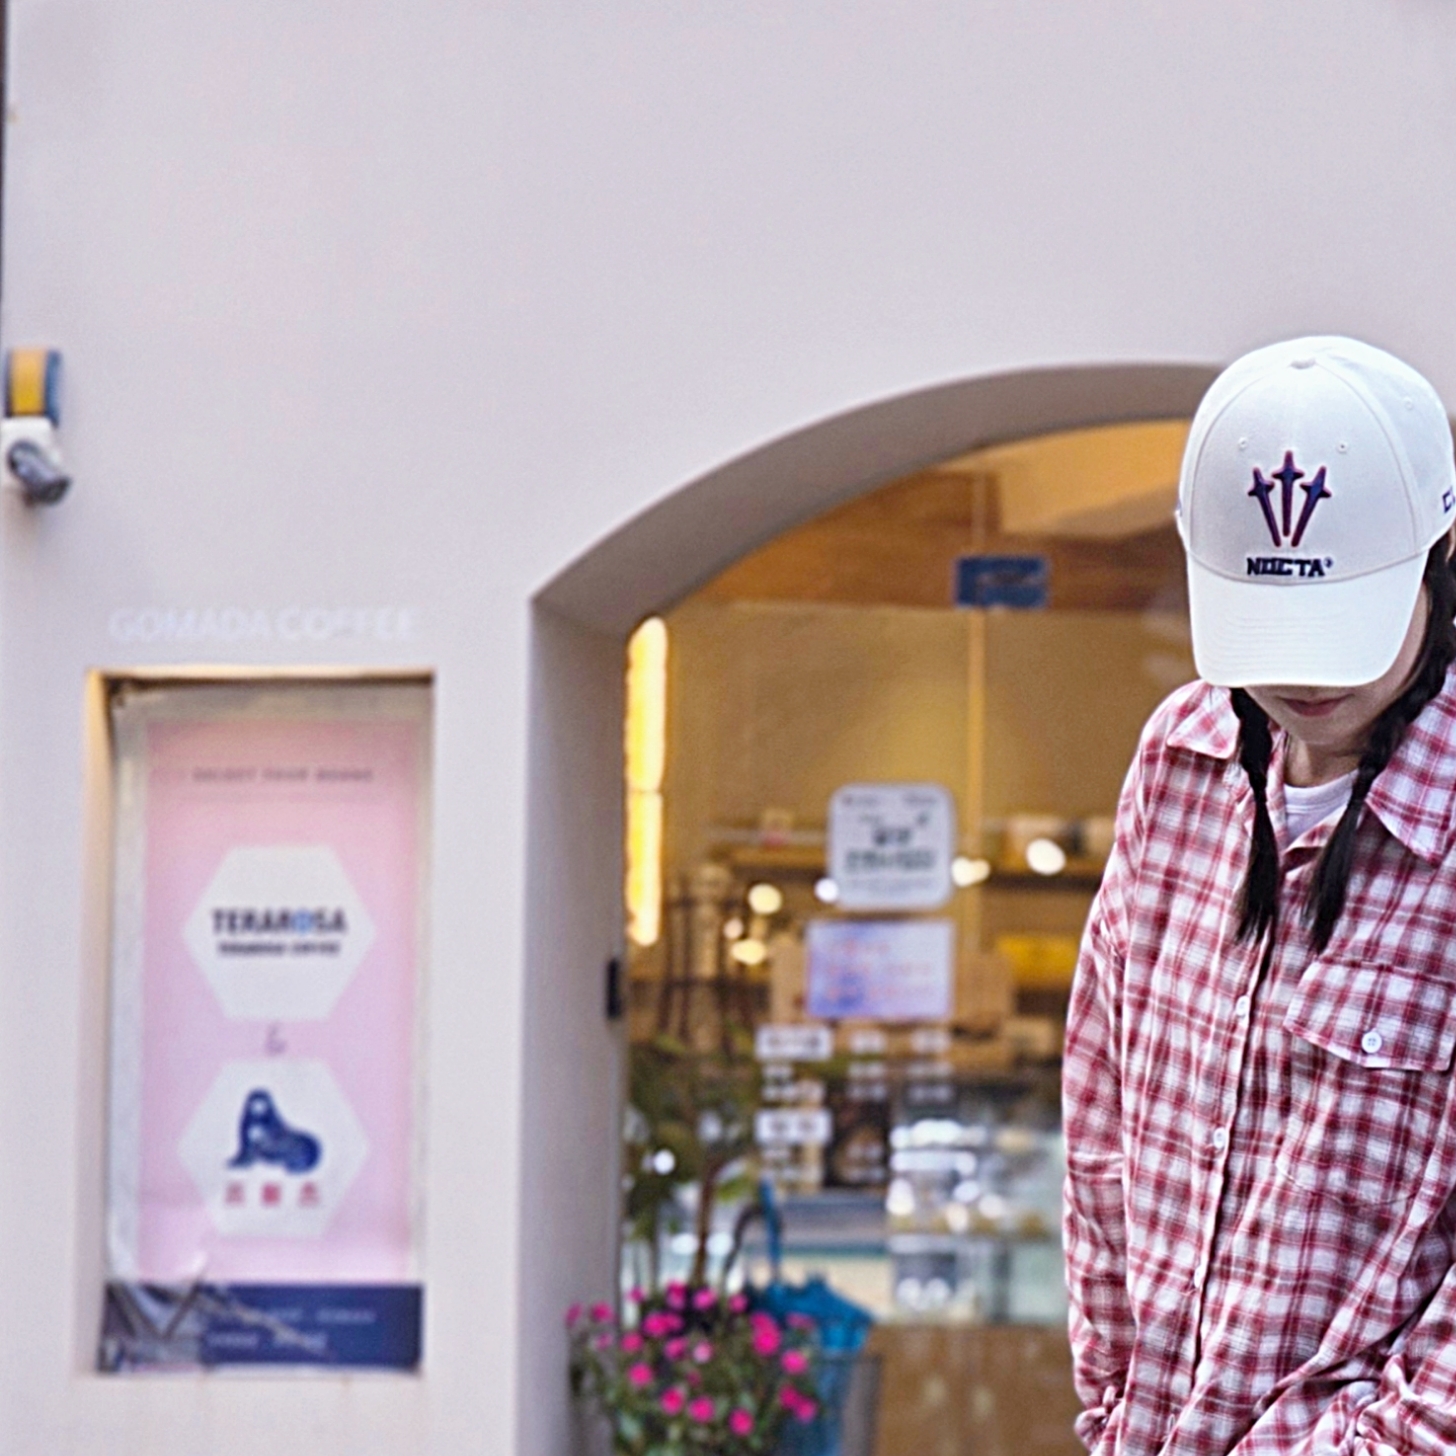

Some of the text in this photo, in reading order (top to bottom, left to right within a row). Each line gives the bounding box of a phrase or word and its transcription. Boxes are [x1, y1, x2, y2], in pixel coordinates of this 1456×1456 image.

[106, 606, 420, 642] GOMADA COFFEE
[211, 908, 348, 935] TERAROSA
